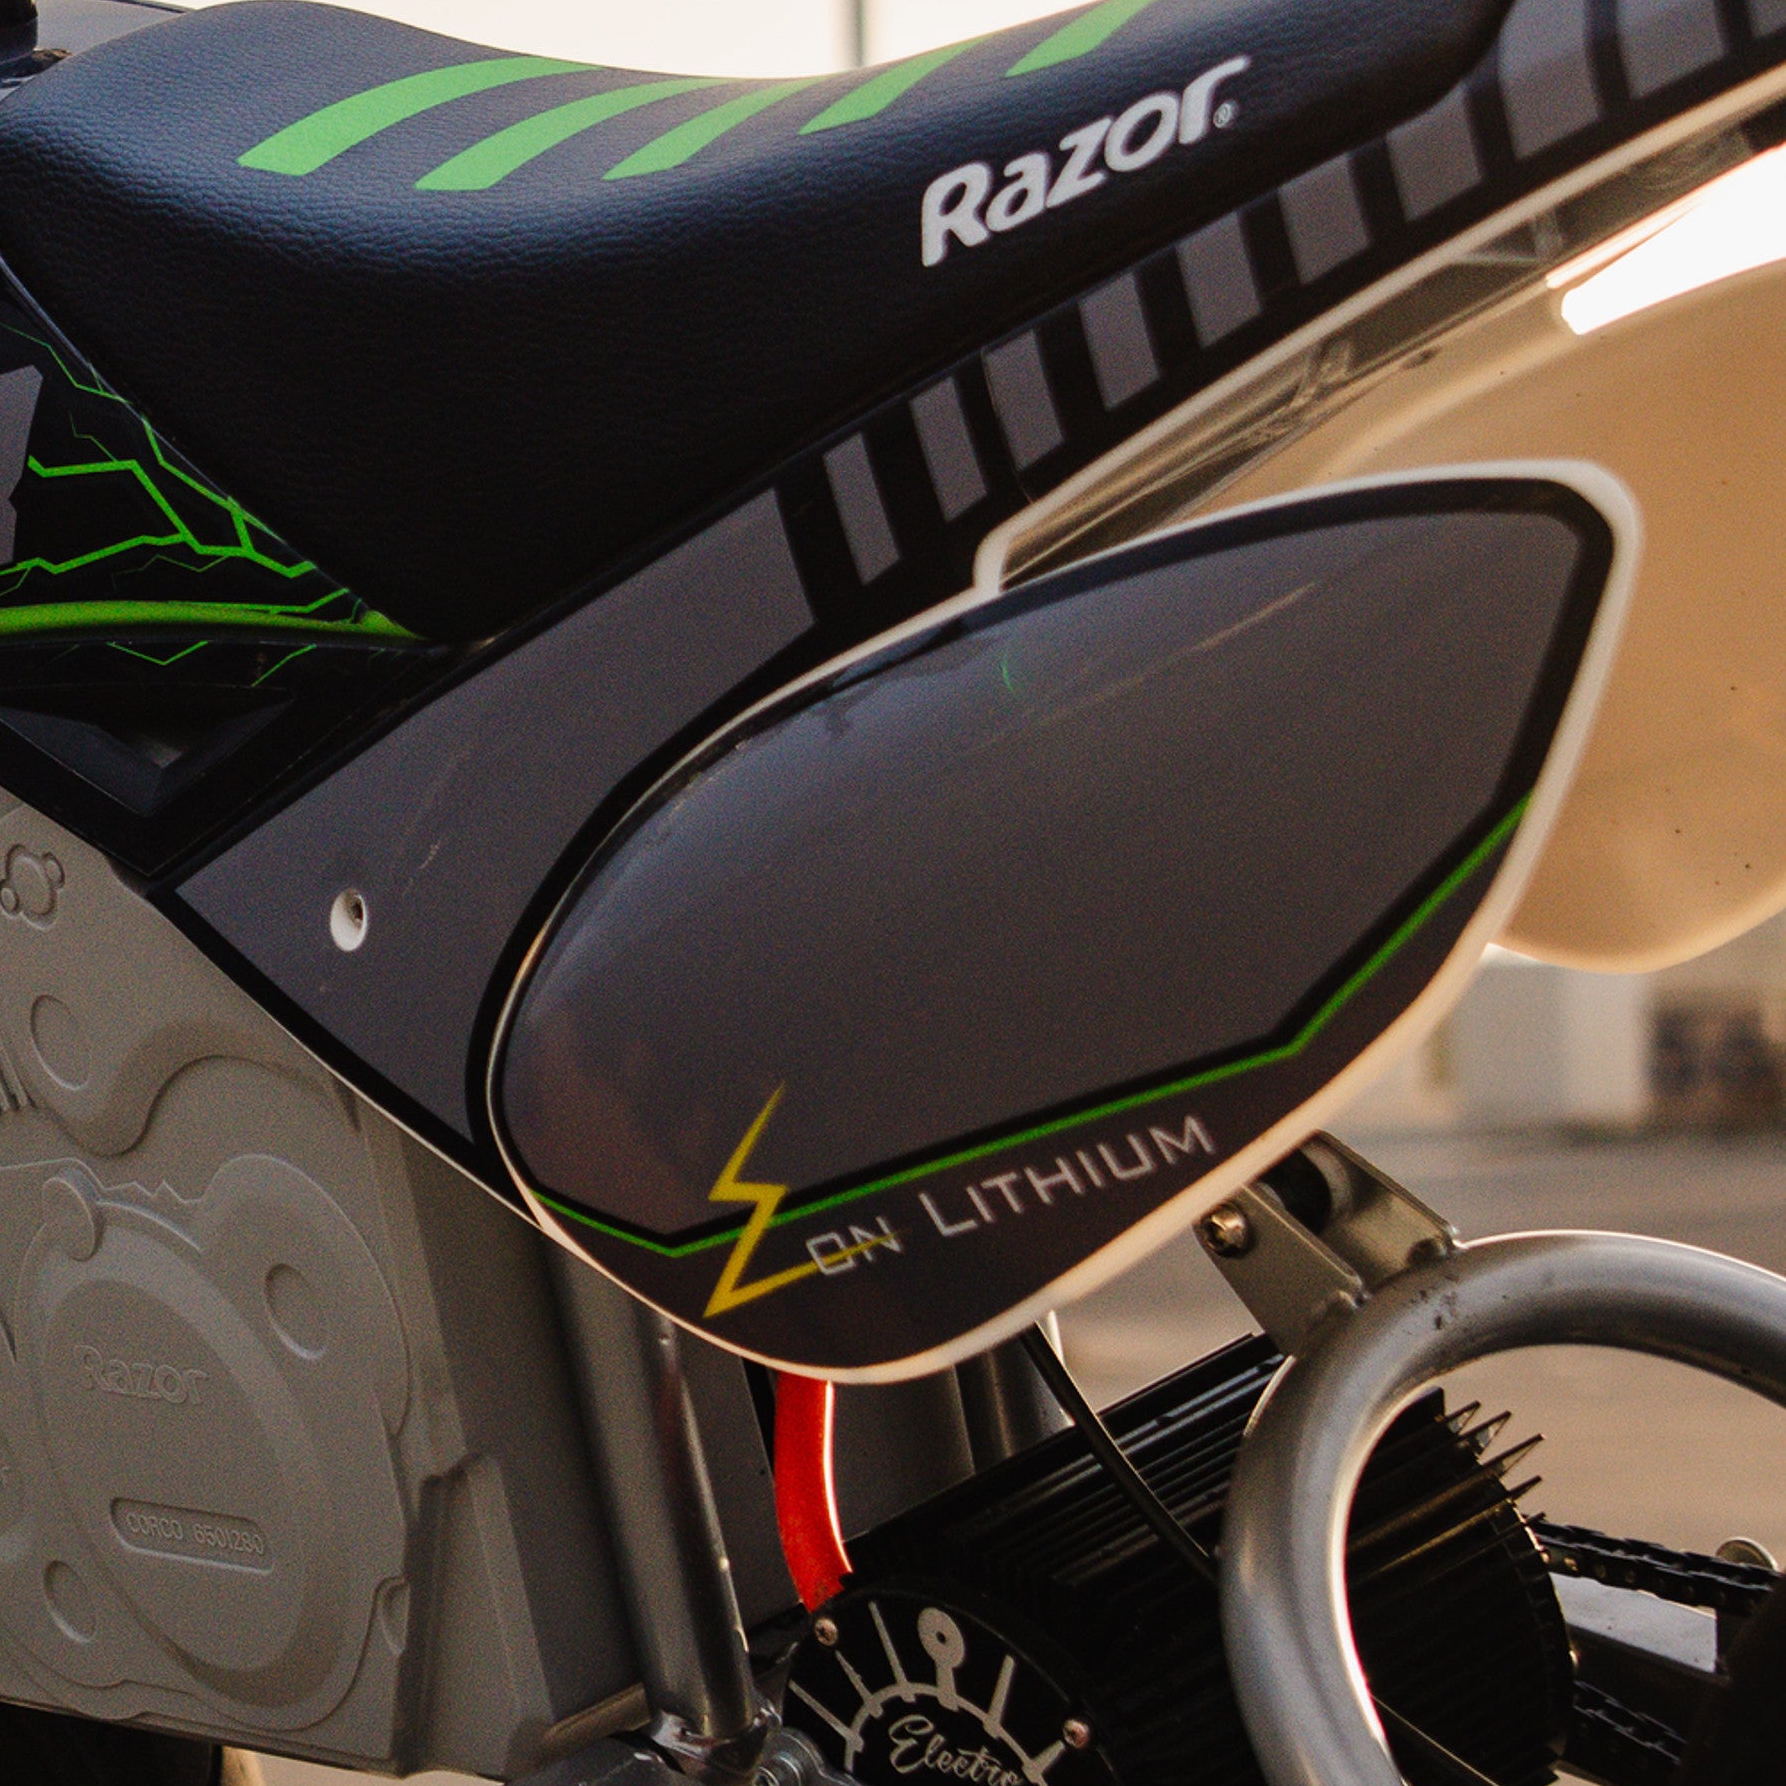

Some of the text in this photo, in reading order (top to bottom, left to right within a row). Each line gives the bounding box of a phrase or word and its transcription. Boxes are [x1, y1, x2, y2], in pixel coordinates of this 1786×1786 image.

[921, 54, 1252, 267] Razor
[919, 1115, 1214, 1238] LITHIUM
[74, 1344, 209, 1404] Razor
